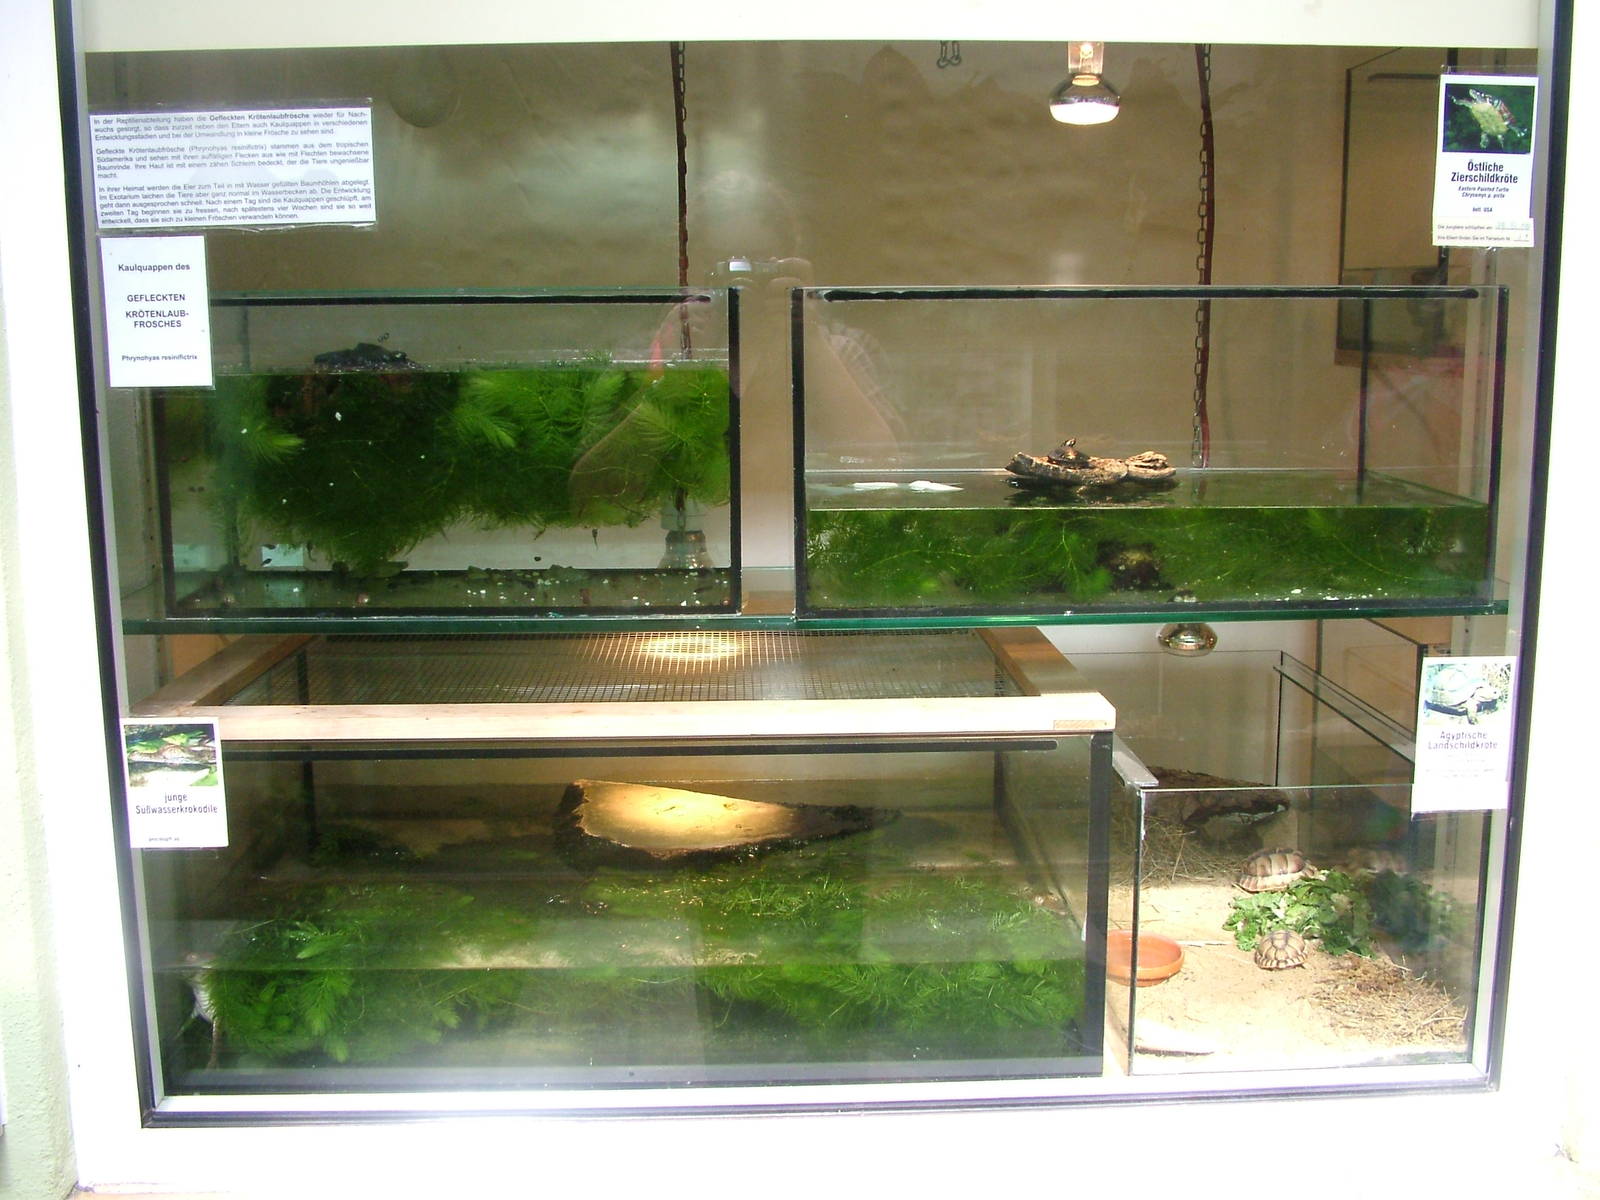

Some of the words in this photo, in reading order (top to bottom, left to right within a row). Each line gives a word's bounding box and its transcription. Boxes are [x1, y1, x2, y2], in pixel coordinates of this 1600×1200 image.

[1467, 159, 1504, 172] Östliche
[1451, 171, 1518, 184] Zierschildkröte
[118, 263, 173, 272] Kaulquappen
[127, 293, 186, 302] GEFLECKTEN
[125, 309, 189, 318] KRÖTENLAUB-
[134, 320, 182, 328] FROSCHES
[165, 792, 188, 803] junge
